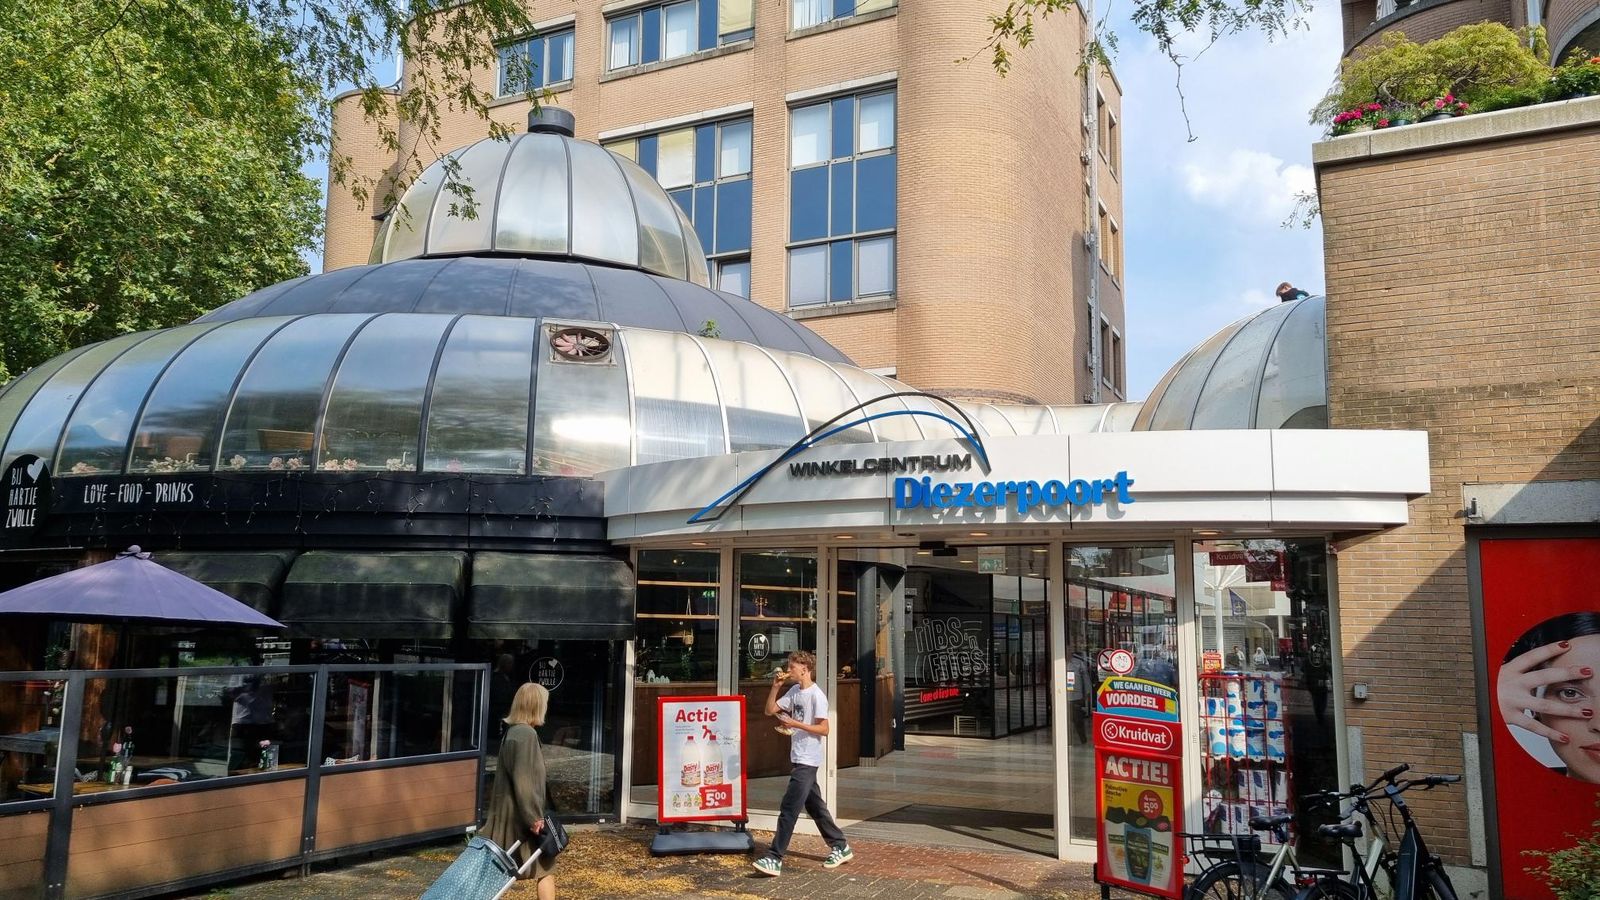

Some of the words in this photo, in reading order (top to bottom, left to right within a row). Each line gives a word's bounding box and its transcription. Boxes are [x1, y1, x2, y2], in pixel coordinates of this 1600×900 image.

[789, 454, 972, 477] WINKELCENTRUM
[11, 468, 22, 486] BIJ
[8, 487, 38, 506] HARTJE
[84, 484, 108, 503] LOVE
[118, 483, 143, 503] FOOD
[155, 482, 194, 503] DRINKS
[895, 470, 1135, 515] Diezerpoort
[6, 508, 37, 528] ZWOLLE
[1216, 552, 1245, 560] Kruidva
[1113, 681, 1124, 690] WE
[1125, 682, 1143, 692] GAAN
[1144, 684, 1152, 693] ER
[1153, 686, 1171, 698] WEER
[1106, 693, 1158, 709] VOORDEEL
[675, 707, 717, 722] Actie
[1118, 726, 1167, 744] Kruidvat
[1105, 755, 1168, 785] ACTIE!
[705, 791, 726, 807] 5.00
